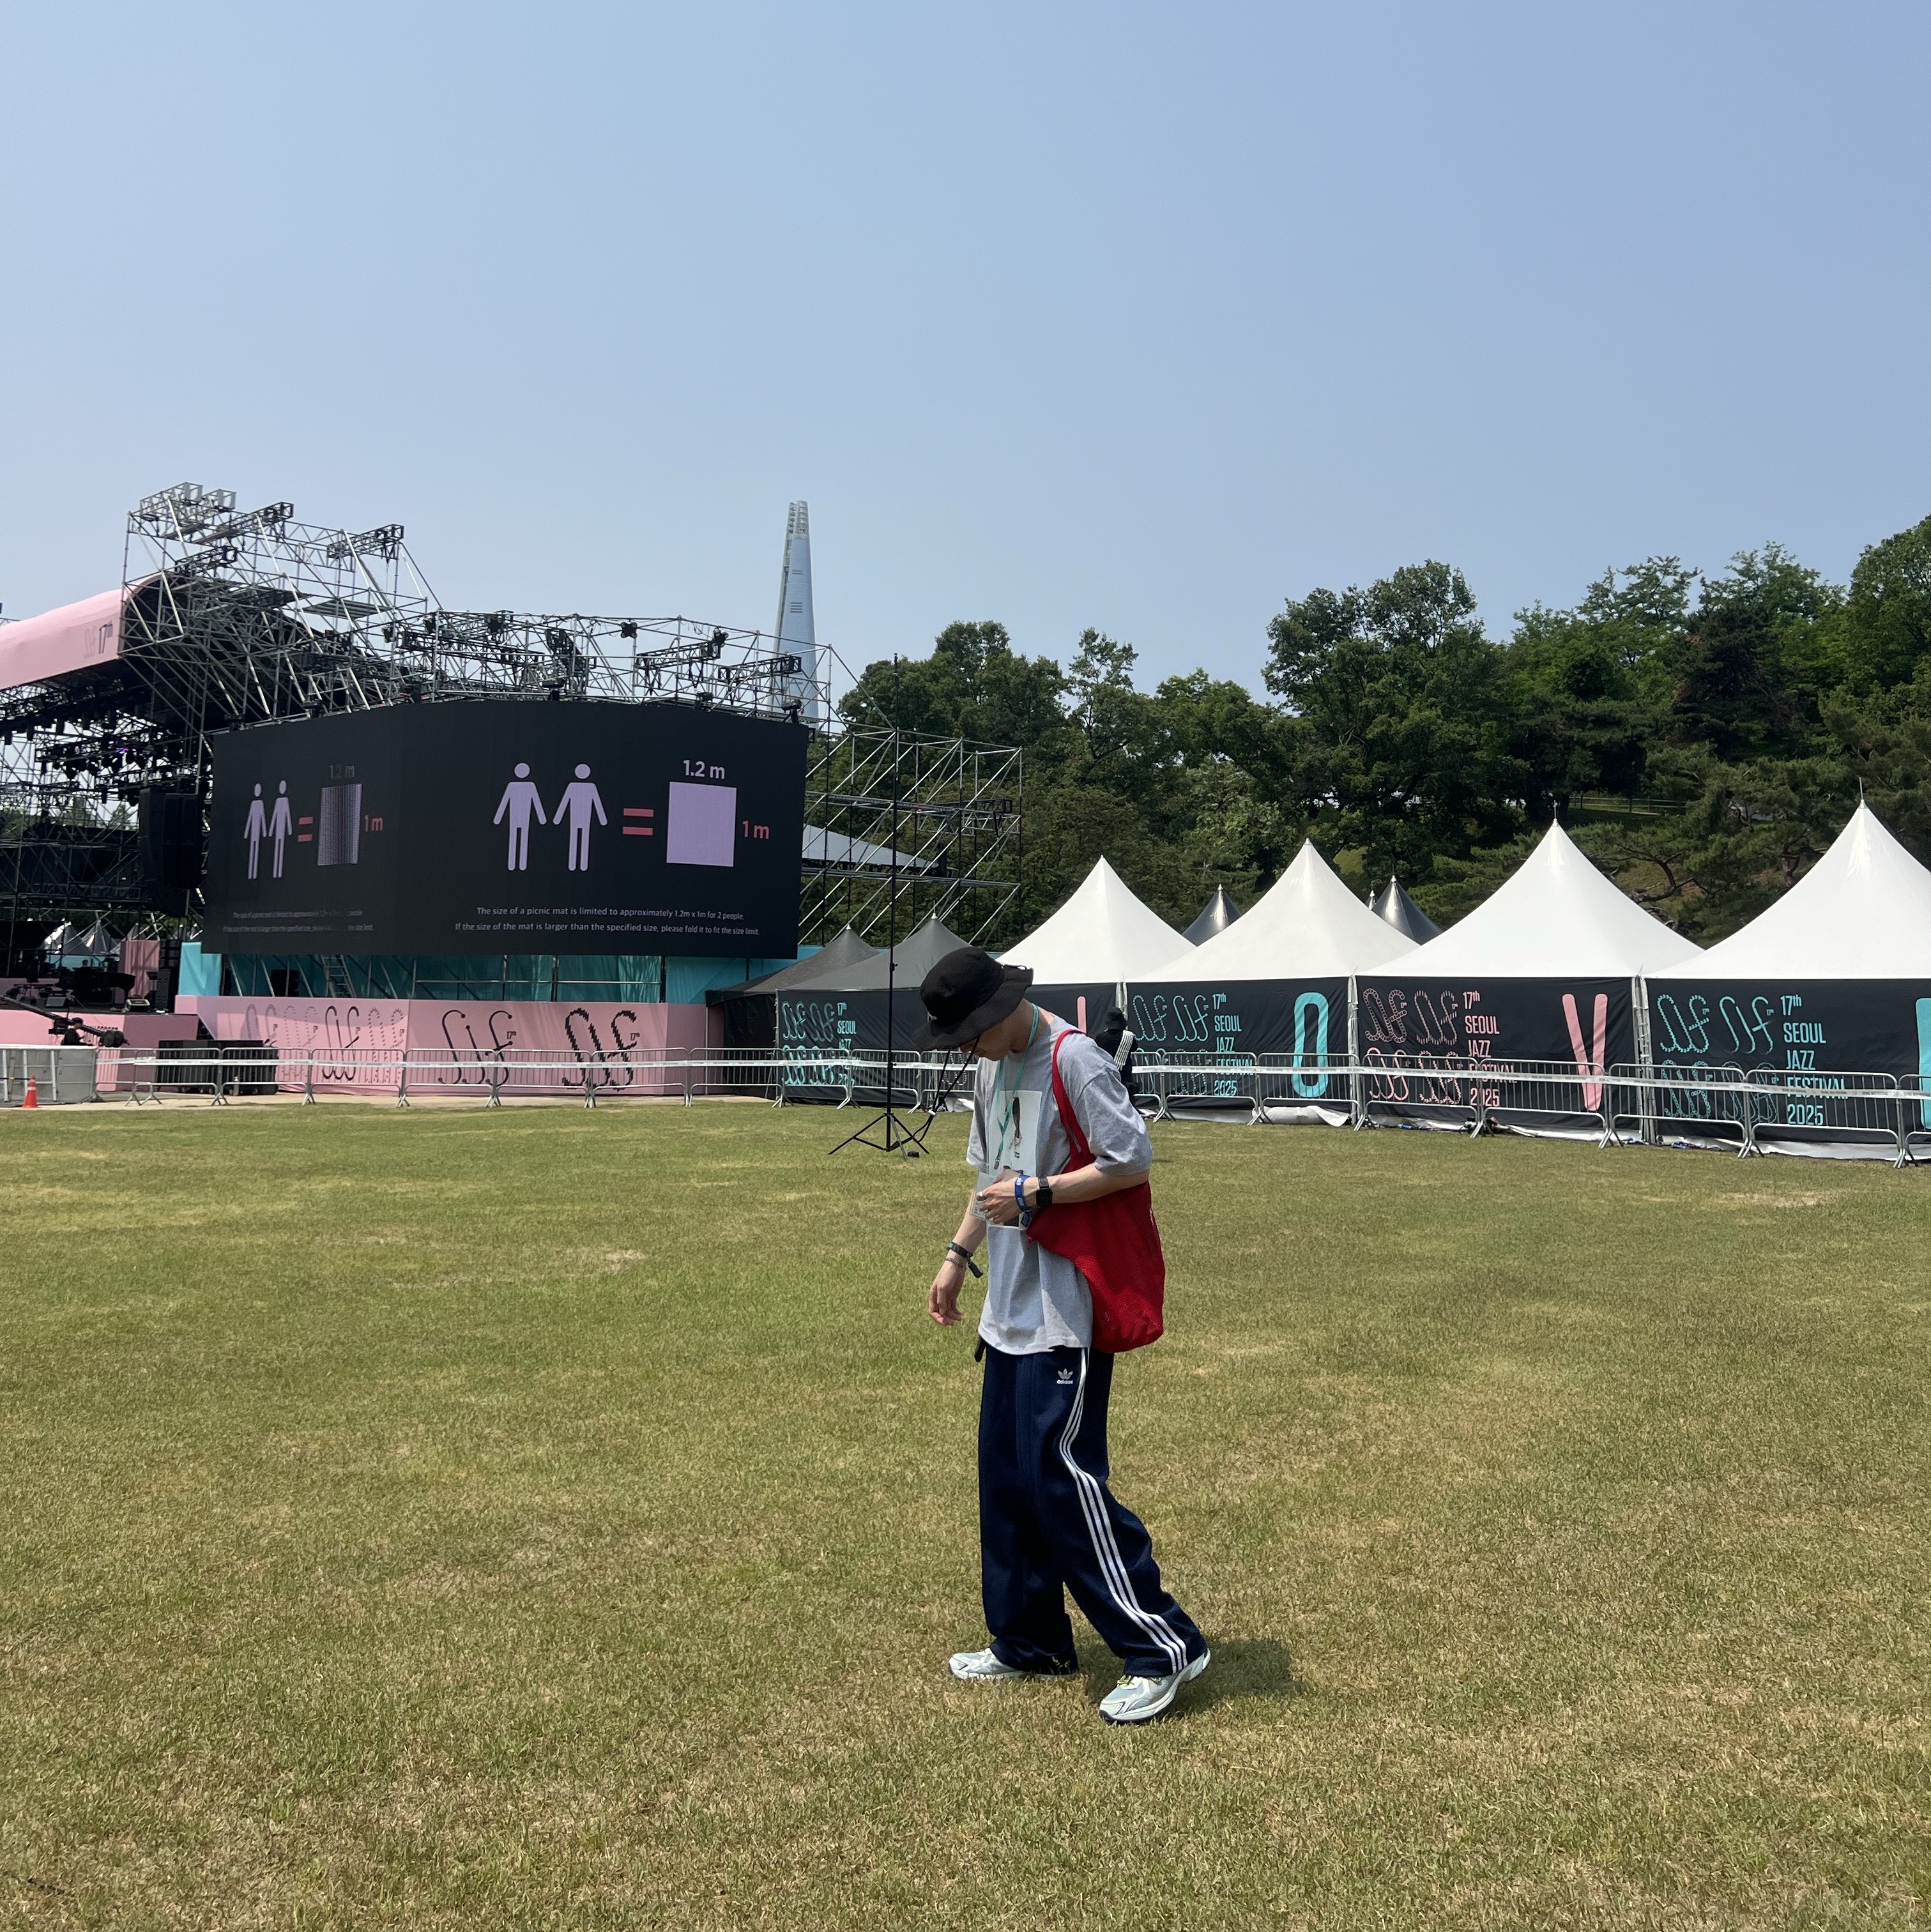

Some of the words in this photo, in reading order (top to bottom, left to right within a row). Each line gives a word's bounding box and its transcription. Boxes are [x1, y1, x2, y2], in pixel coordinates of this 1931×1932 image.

[683, 759, 706, 777] 1.2
[710, 765, 726, 779] m
[742, 821, 749, 838] 1
[753, 825, 770, 840] m
[510, 906, 519, 915] of
[526, 907, 551, 916] picnic
[620, 909, 673, 918] approximately
[675, 909, 690, 918] 1.2m
[607, 924, 641, 932] specified
[1212, 993, 1227, 1010] 17th
[1463, 991, 1481, 1010] 17th
[1780, 994, 1803, 1016] 17th
[837, 1020, 857, 1035] SEOUL
[1214, 1015, 1242, 1032] SEOUL
[1465, 1015, 1500, 1035] SEOUL
[1783, 1023, 1827, 1044] SEOUL
[1216, 1037, 1235, 1053] JAZZ
[1468, 1039, 1492, 1058] JAZZ
[1562, 993, 1608, 1111] V
[1786, 1049, 1816, 1070] JAZZ
[1214, 1080, 1238, 1097] 2025
[1788, 1104, 1824, 1126] 2025
